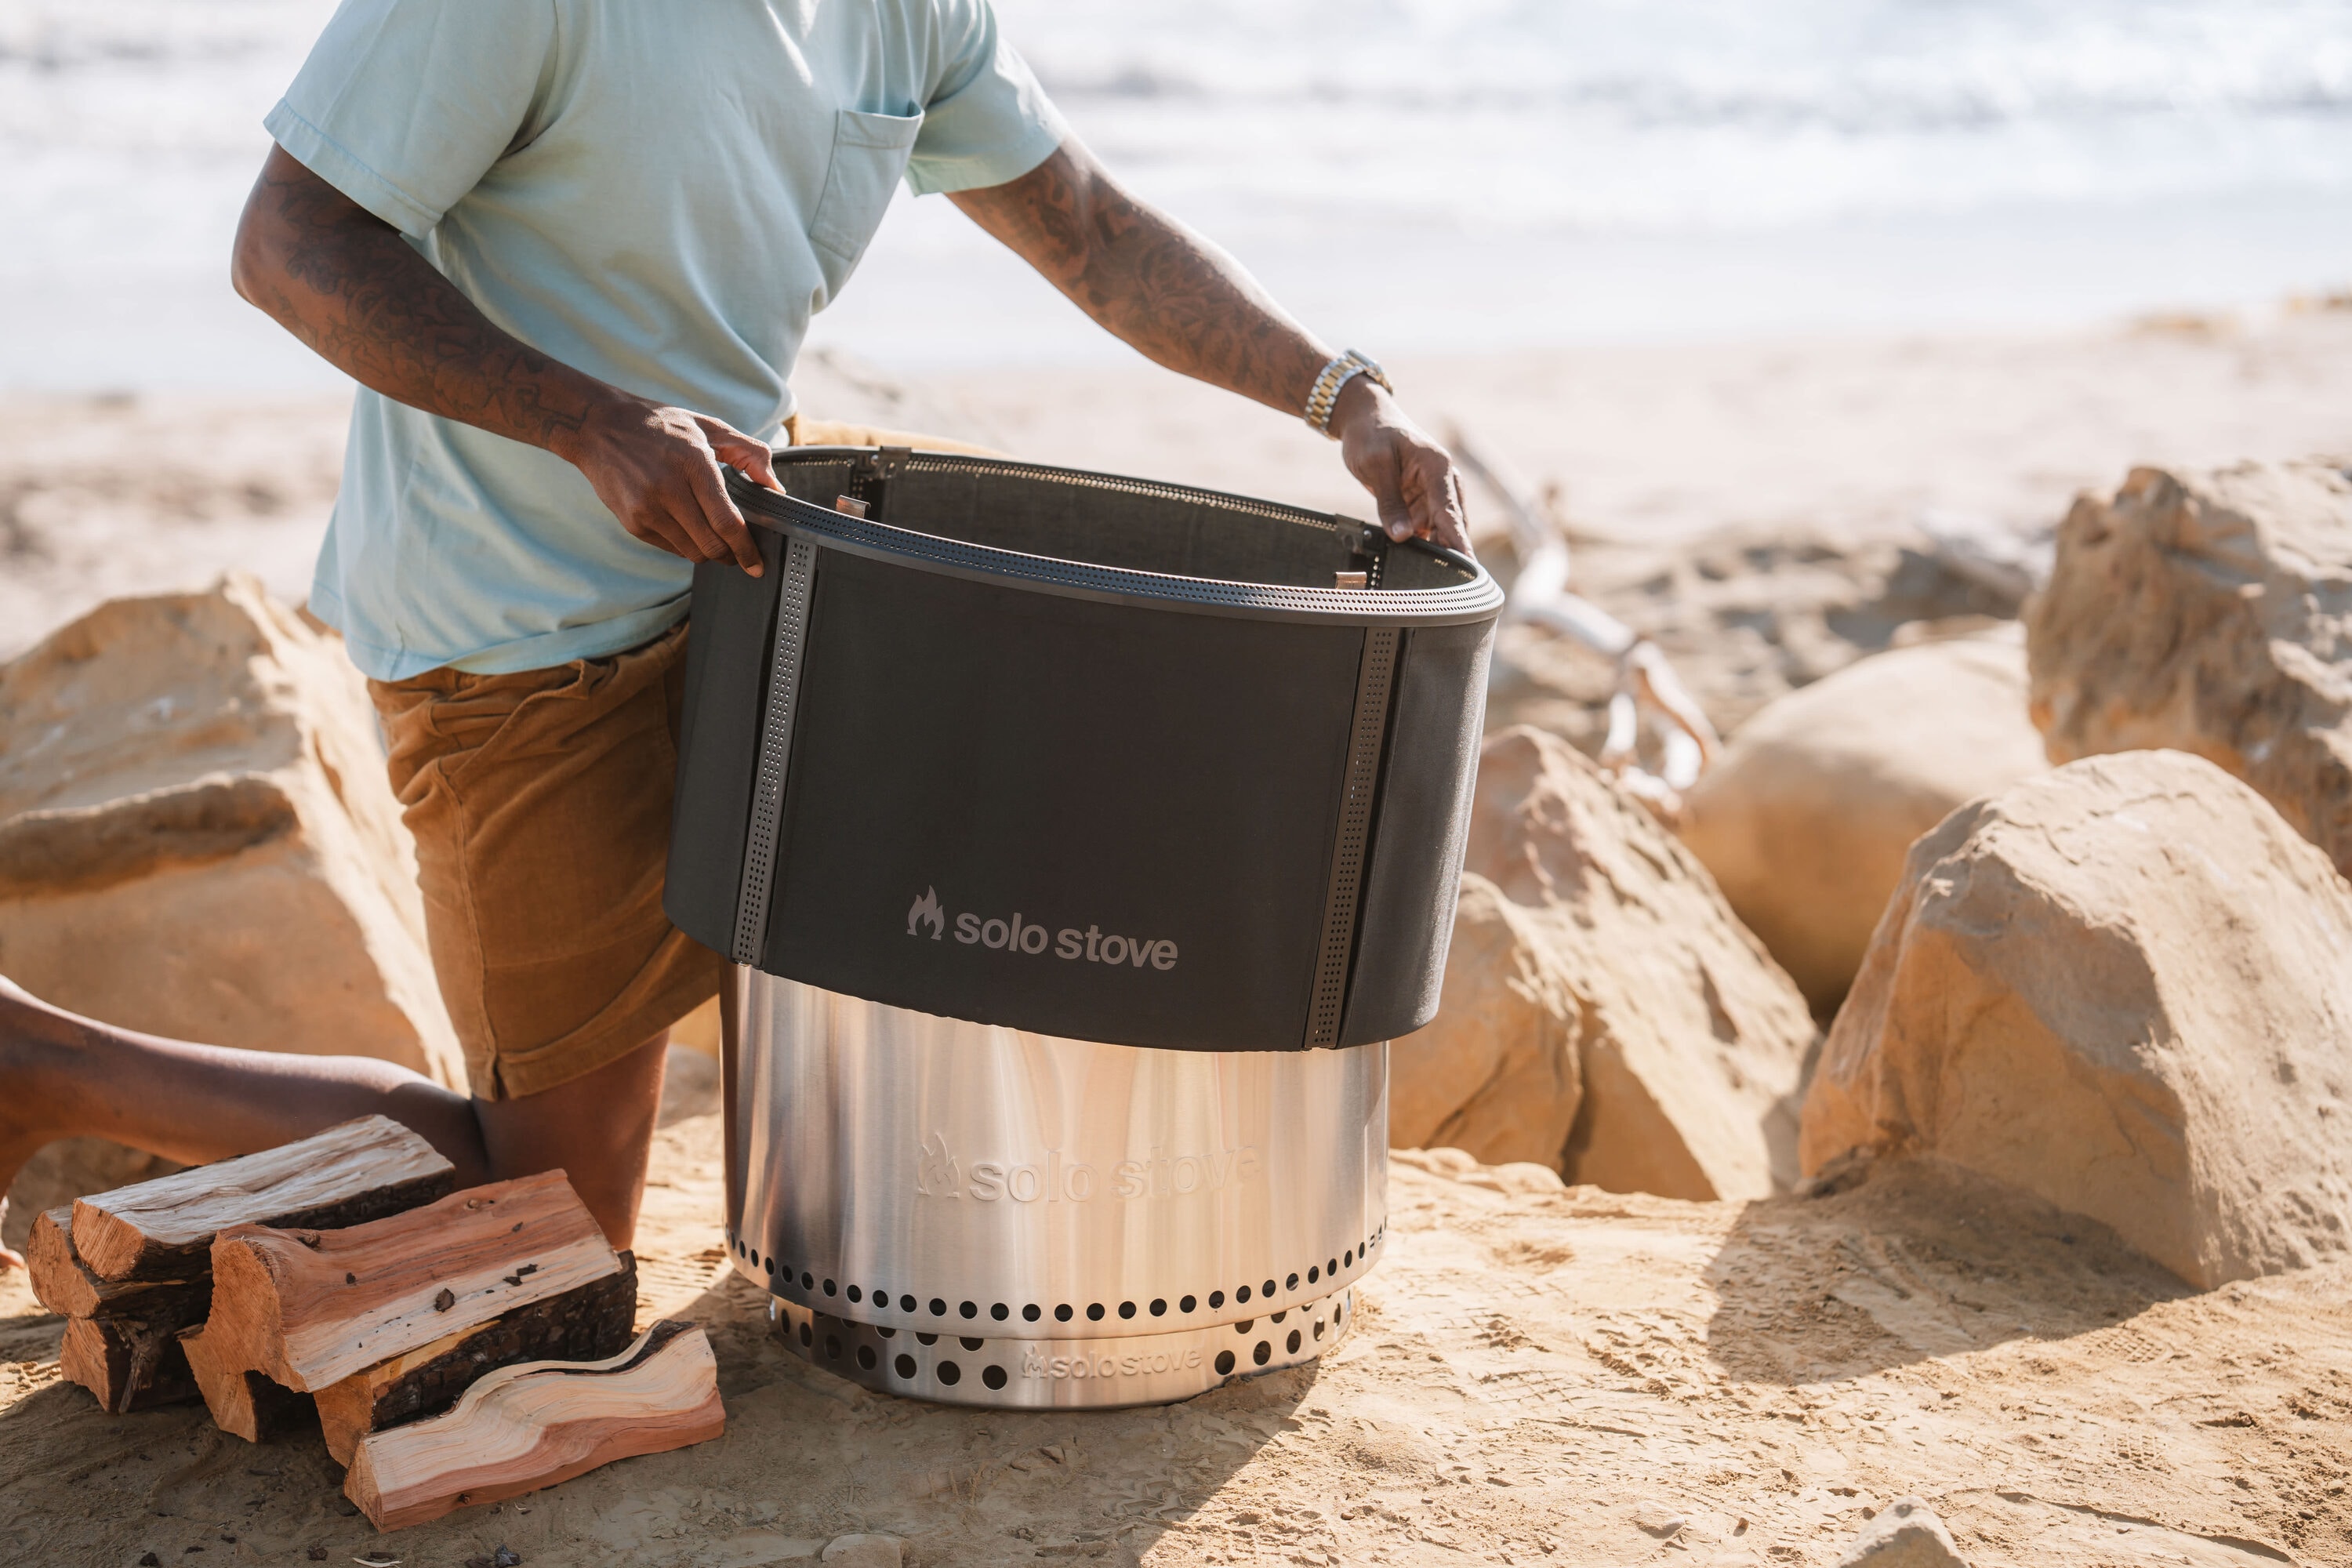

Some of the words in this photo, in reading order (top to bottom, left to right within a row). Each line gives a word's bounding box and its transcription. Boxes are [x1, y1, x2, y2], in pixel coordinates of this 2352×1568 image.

[954, 913, 1048, 954] solo
[1054, 924, 1178, 971] stove
[969, 1149, 1096, 1202] solo
[1109, 1145, 1261, 1199] stove
[1049, 1350, 1116, 1378] solo
[1121, 1349, 1202, 1376] stove
